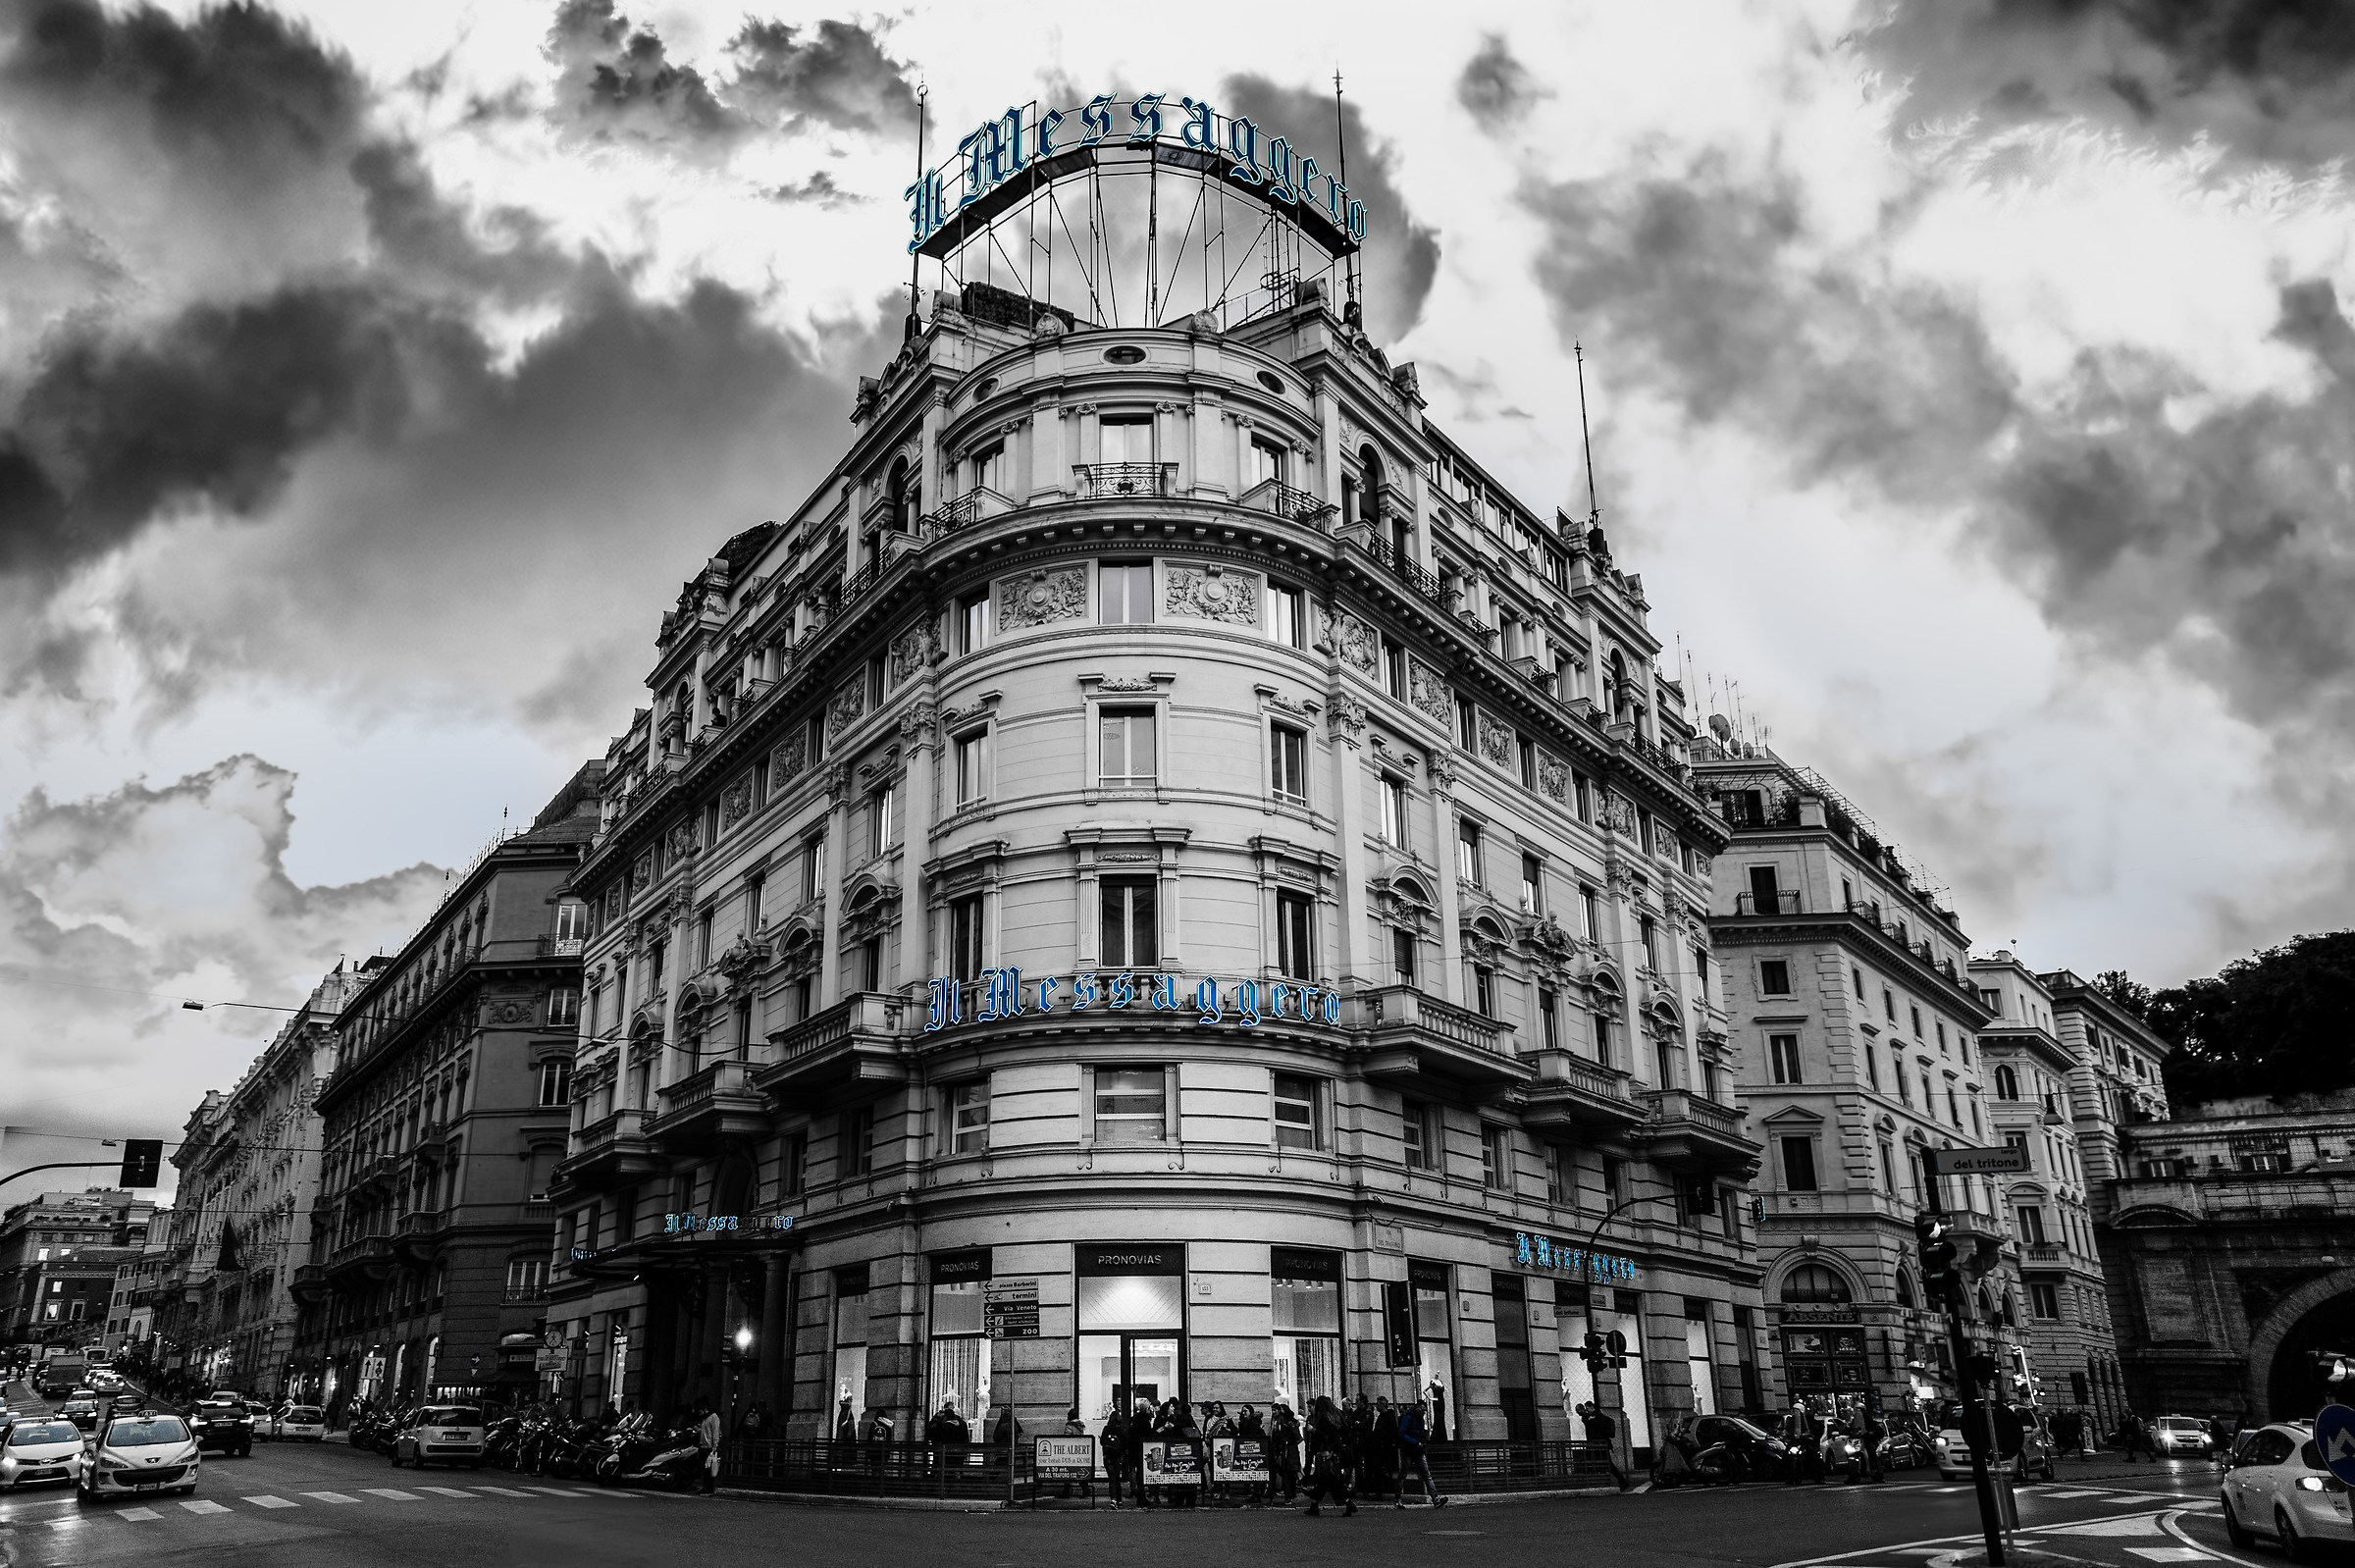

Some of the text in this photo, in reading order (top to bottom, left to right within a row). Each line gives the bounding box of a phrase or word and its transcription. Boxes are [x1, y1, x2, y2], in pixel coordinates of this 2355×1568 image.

[957, 90, 1368, 242] Messaggero
[977, 963, 1342, 1028] Messaggero
[1954, 1159, 2019, 1170] del tritone
[1098, 1255, 1162, 1265] PRONOVIAS
[1534, 1234, 1635, 1284] Messggero
[940, 1261, 979, 1273] PRONOVIAS
[1053, 1444, 1090, 1455] THE ALBERT
